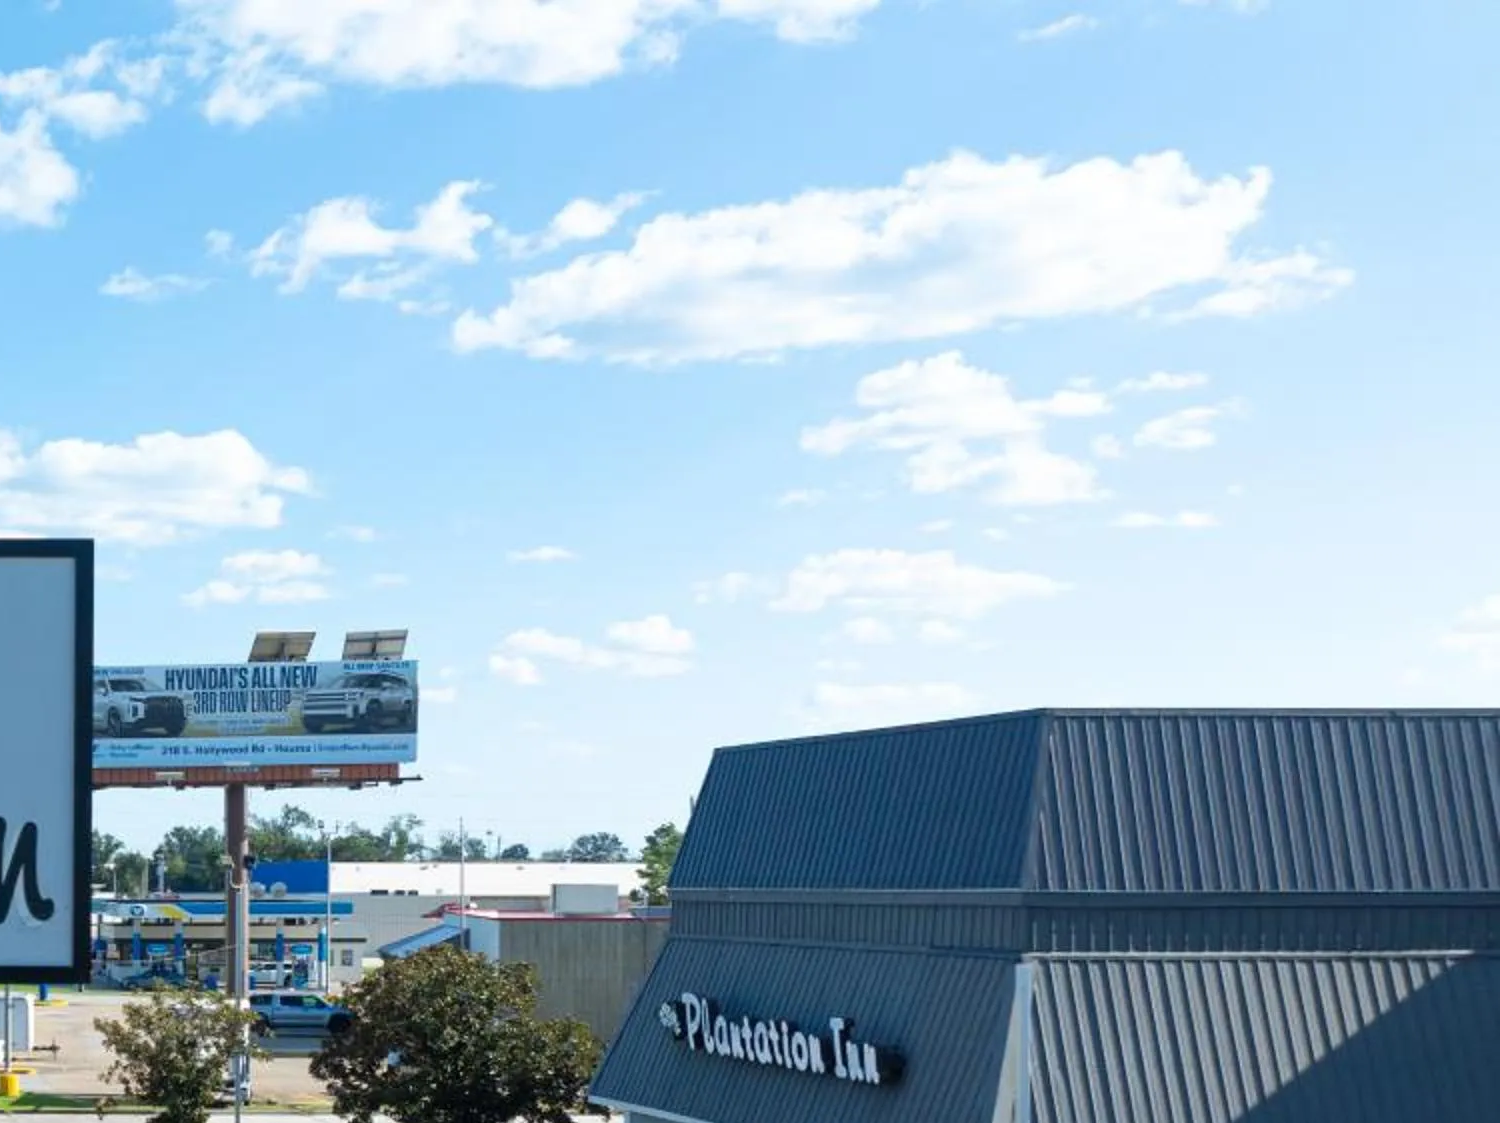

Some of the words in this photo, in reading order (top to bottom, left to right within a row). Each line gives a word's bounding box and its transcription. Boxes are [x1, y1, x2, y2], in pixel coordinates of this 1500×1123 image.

[165, 667, 249, 690] HYUNDAI'S
[252, 666, 277, 688] ALL
[280, 665, 317, 687] NEW
[193, 691, 216, 714] 3RD
[219, 690, 249, 713] ROW
[252, 689, 291, 713] LINEUP
[681, 992, 825, 1074] Plantation
[829, 1016, 881, 1085] Inn
